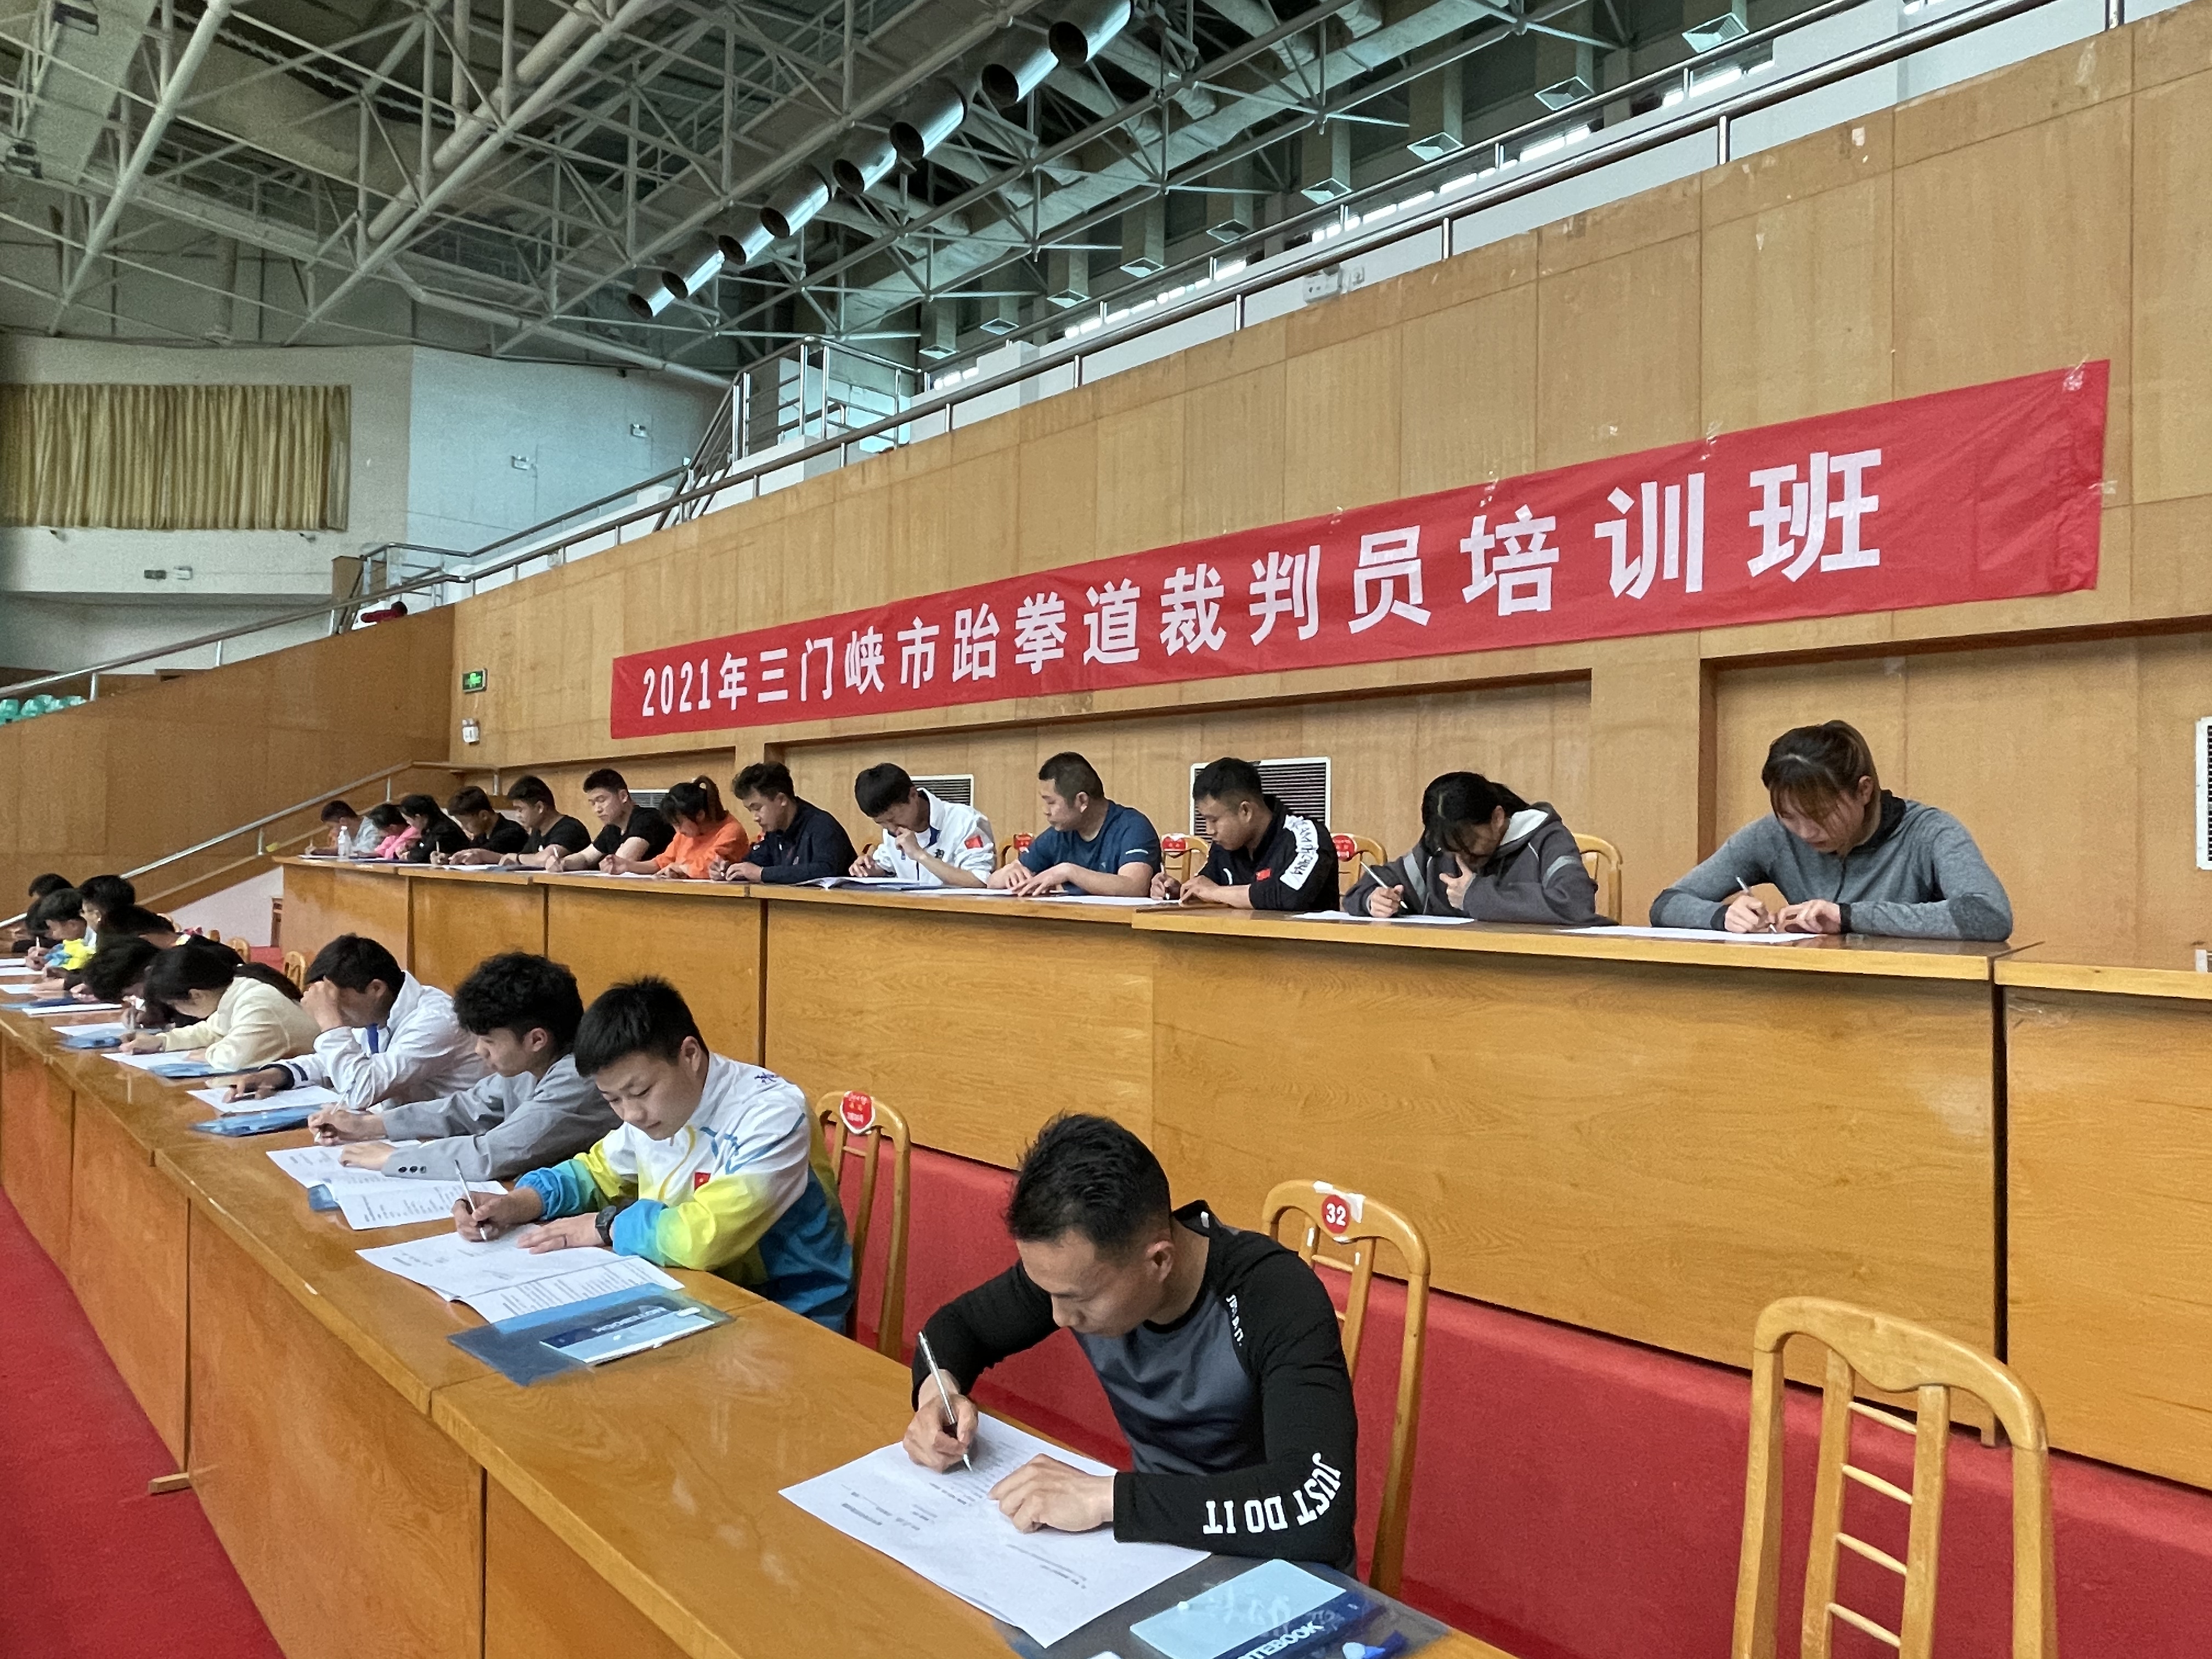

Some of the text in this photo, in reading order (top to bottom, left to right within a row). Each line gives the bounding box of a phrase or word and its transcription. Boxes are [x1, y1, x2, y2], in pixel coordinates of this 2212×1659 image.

[642, 448, 1882, 717] 2021年三门峡市跆拳道裁判员培训班
[1326, 1203, 1346, 1227] 32
[1202, 1452, 1341, 1534] JUST DO IT
